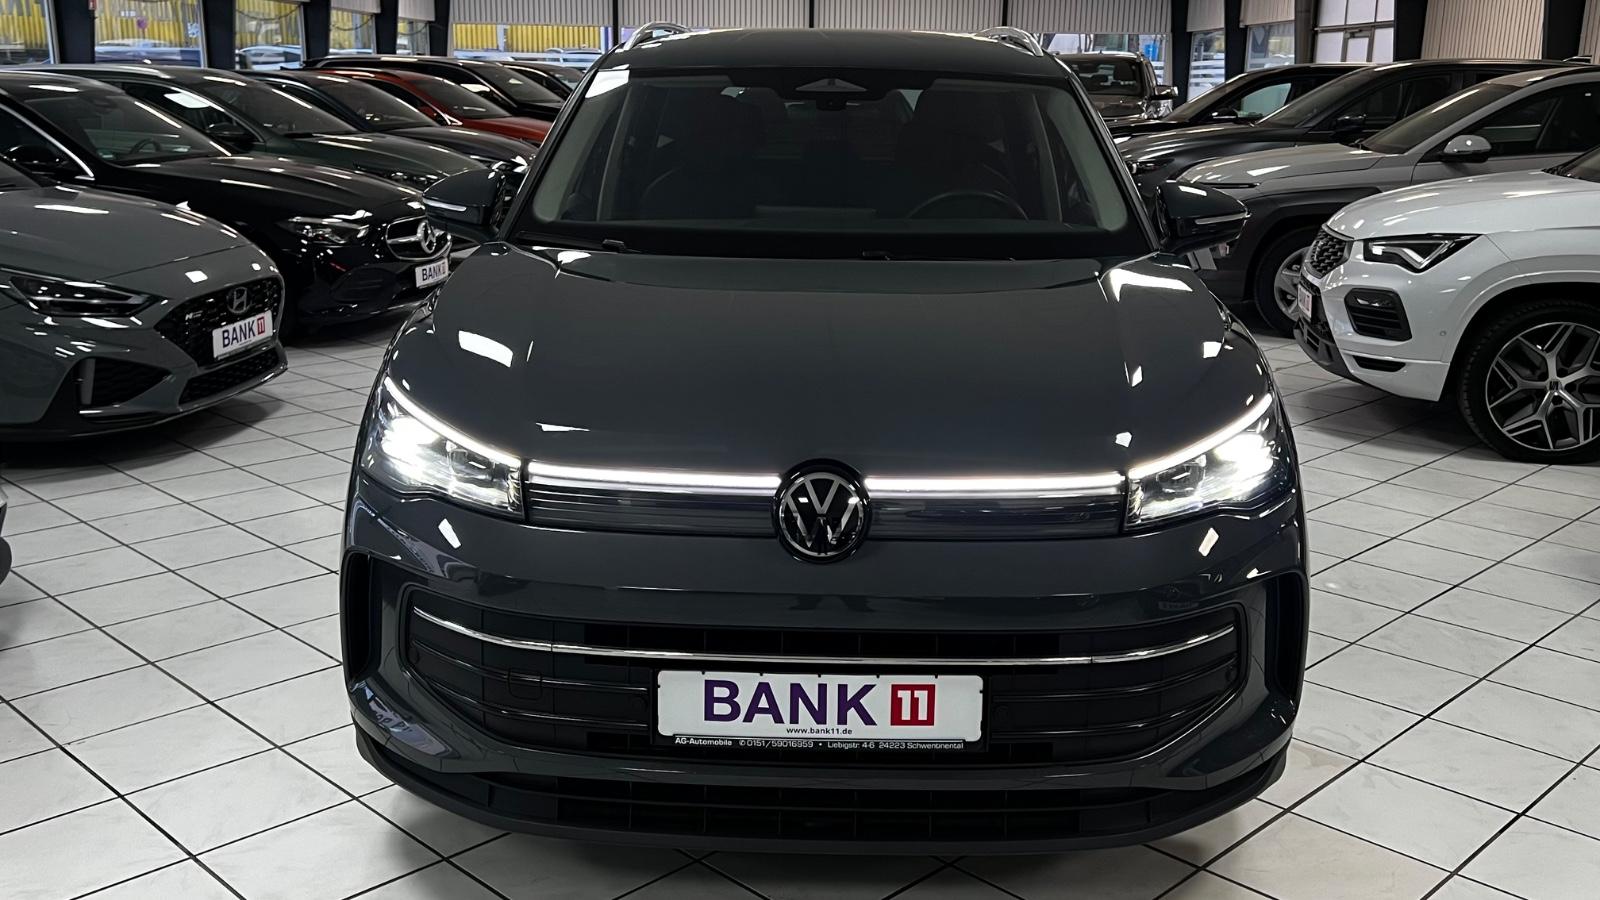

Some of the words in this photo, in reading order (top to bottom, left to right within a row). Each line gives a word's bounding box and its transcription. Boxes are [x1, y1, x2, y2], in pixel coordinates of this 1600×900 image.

[222, 319, 256, 348] BANK
[704, 679, 877, 726] BANK
[895, 688, 931, 722] 11
[786, 727, 853, 735] www.bank11.de
[674, 737, 733, 747] AG-Automobile
